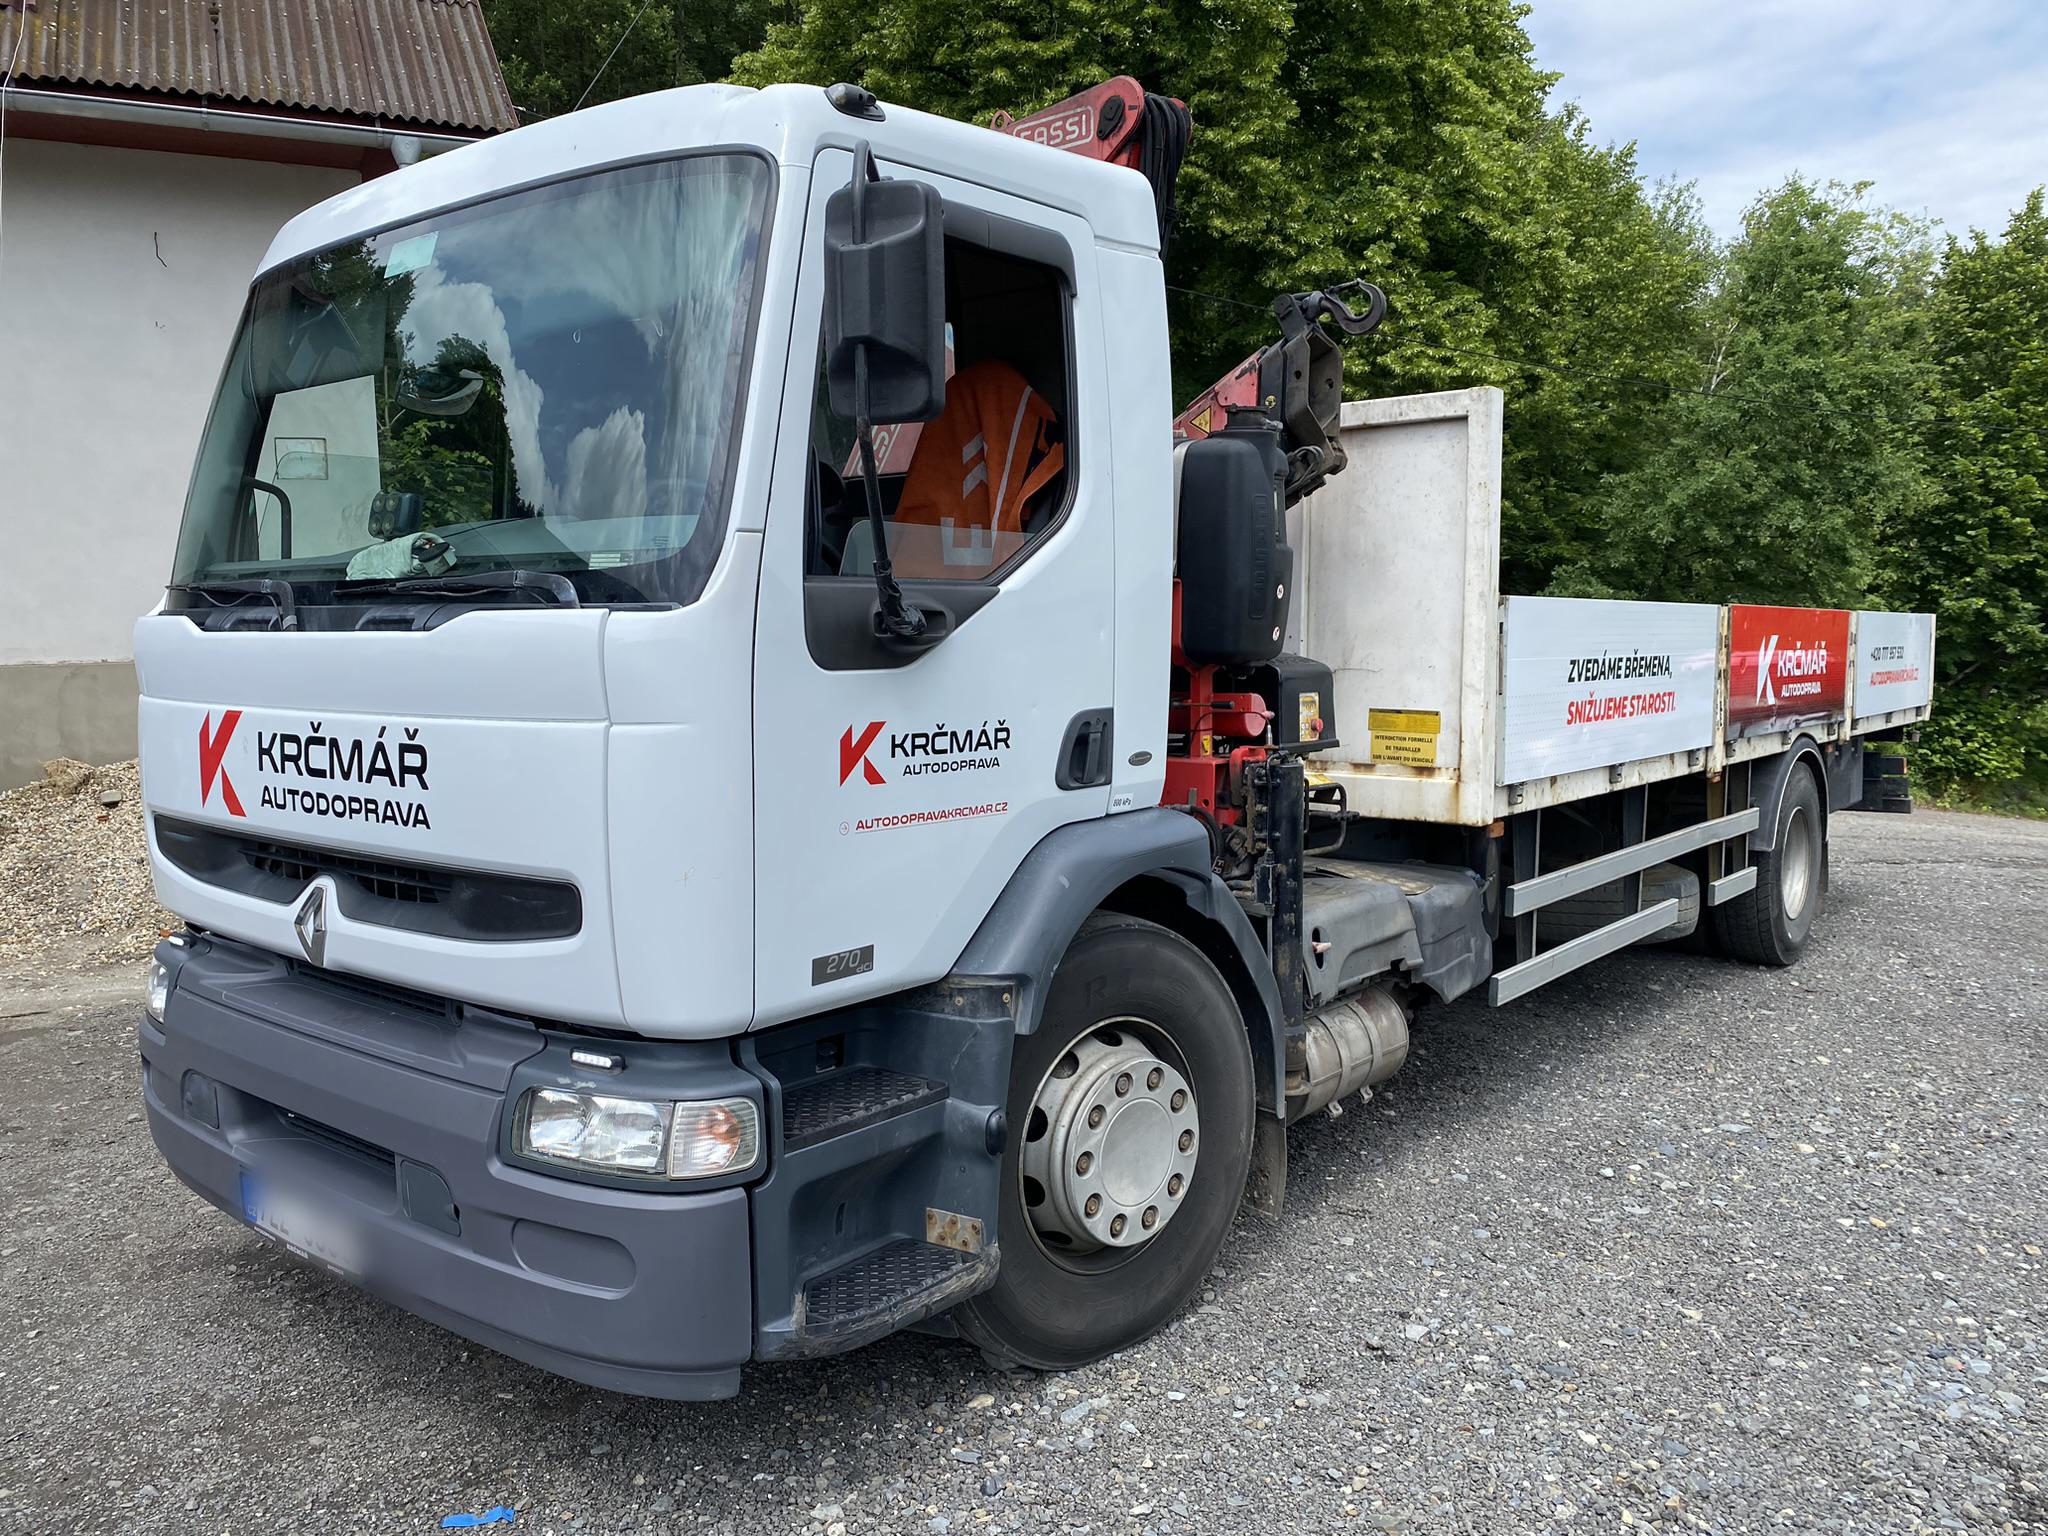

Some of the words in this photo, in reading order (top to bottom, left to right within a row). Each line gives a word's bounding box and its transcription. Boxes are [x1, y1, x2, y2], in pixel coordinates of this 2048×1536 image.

[1567, 649, 1623, 683] ZVEDÁME
[1623, 648, 1672, 679] BŘEMENA,
[1777, 641, 1827, 677] KRČMÁŘ
[1780, 681, 1821, 697] AUTODOPRAVA
[1567, 691, 1628, 725] SNIŽUJEME
[257, 721, 429, 790] KRČMÁŘ
[890, 719, 1011, 759] KRČMÁŘ
[902, 757, 1001, 776] AUTODOPRAVA
[260, 784, 432, 830] AUTODOPRAVA
[855, 801, 1009, 831] AUTODOPRAVAKRCMAR.CZ
[827, 950, 861, 974] 270
